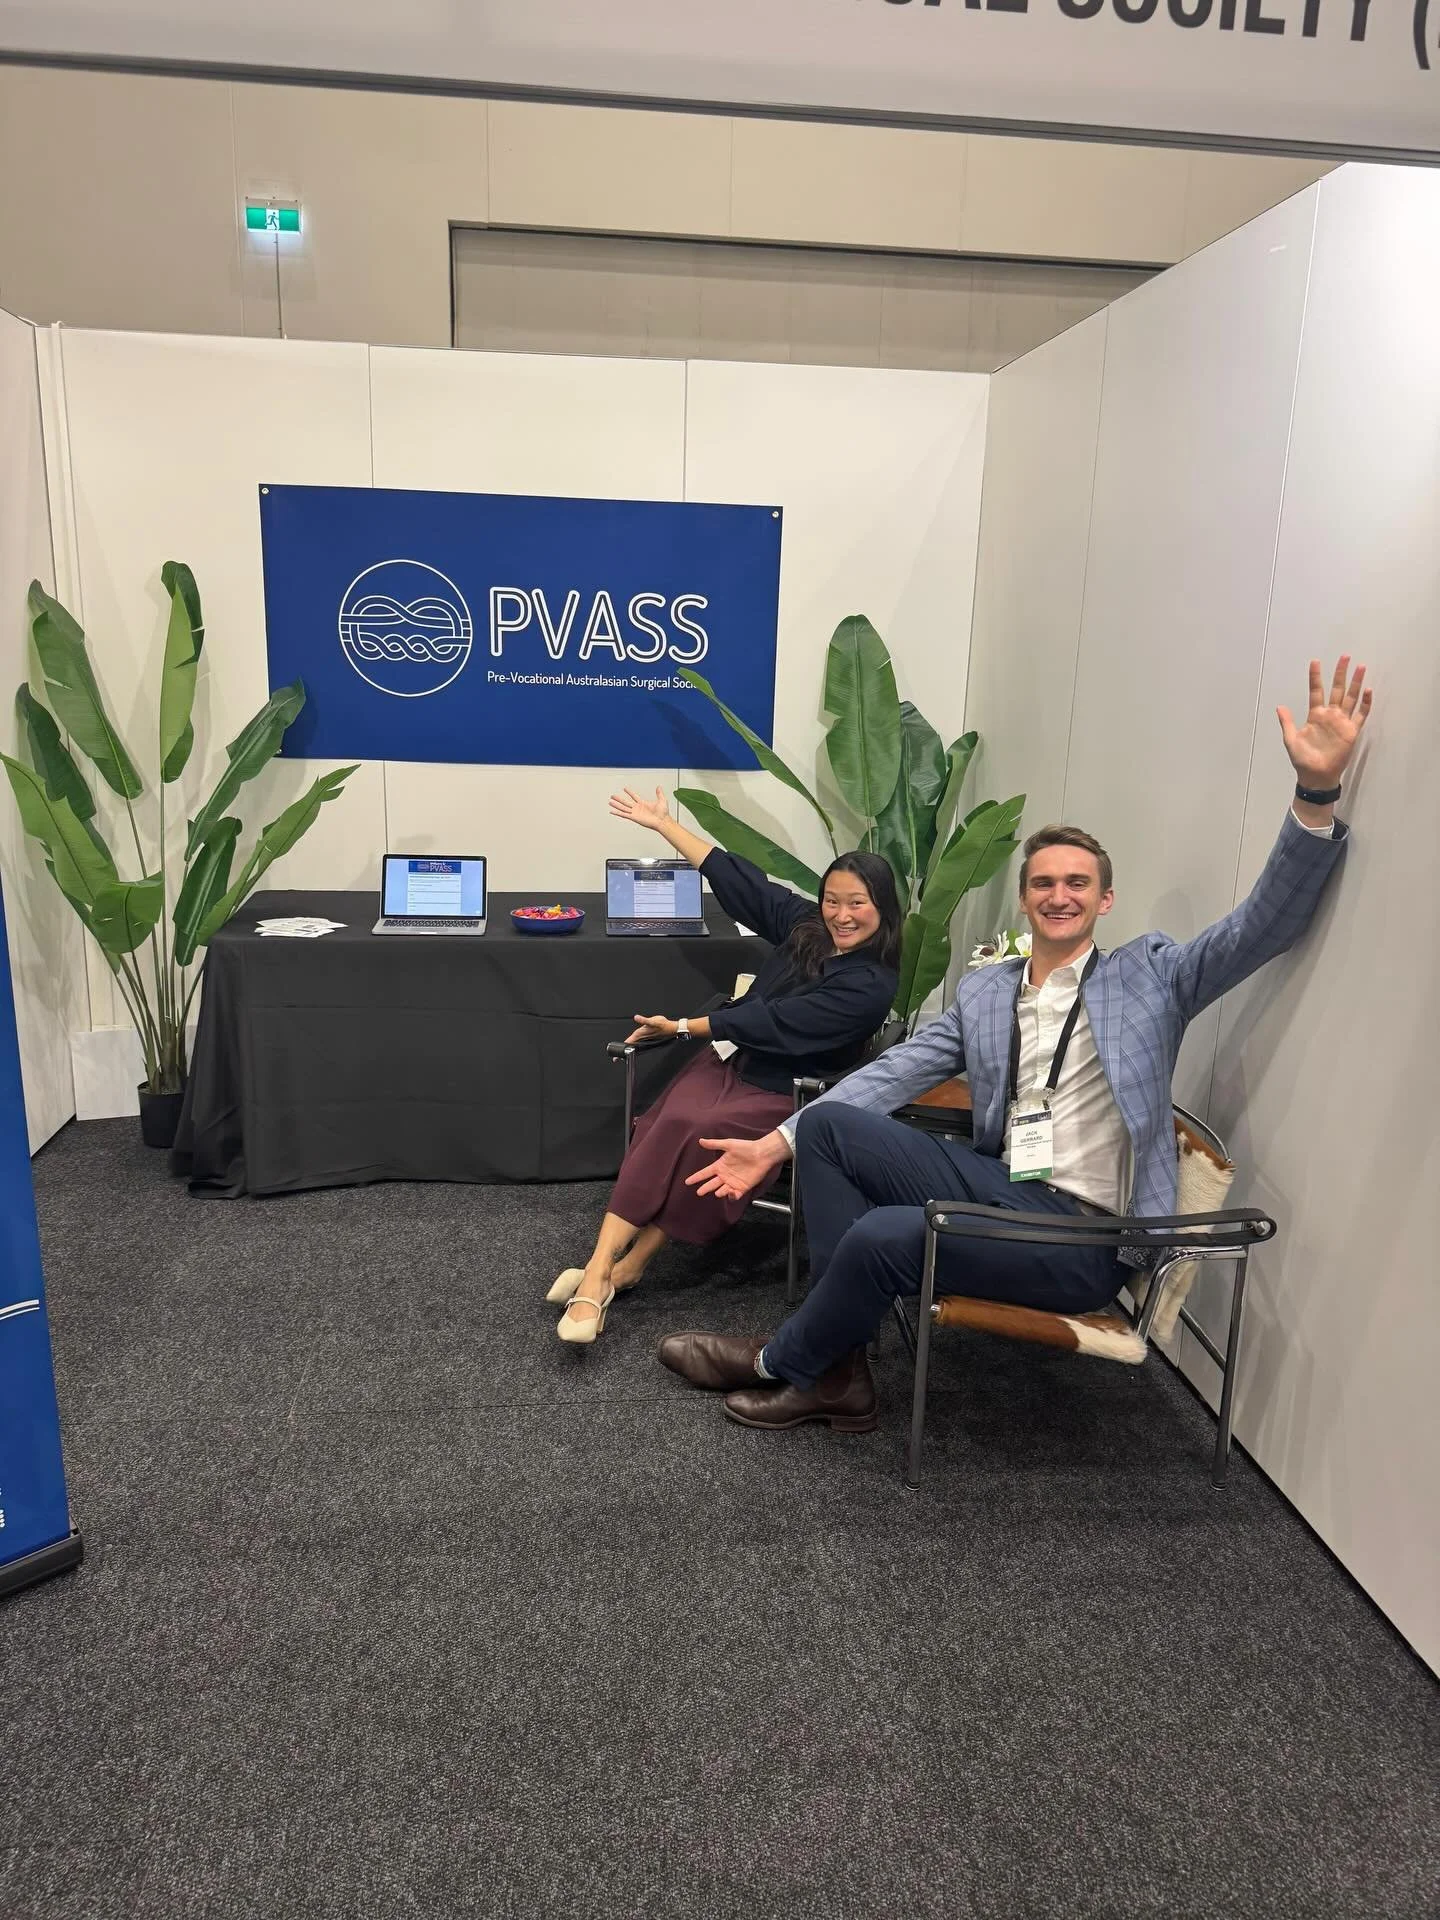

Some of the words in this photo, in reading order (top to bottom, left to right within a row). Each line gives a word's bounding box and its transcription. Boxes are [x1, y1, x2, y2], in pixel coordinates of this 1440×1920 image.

[489, 586, 709, 664] PVASS
[487, 670, 564, 685] Pre-Vocational
[566, 673, 628, 687] Australasian
[630, 675, 671, 691] Surgical
[672, 676, 698, 689] Soci
